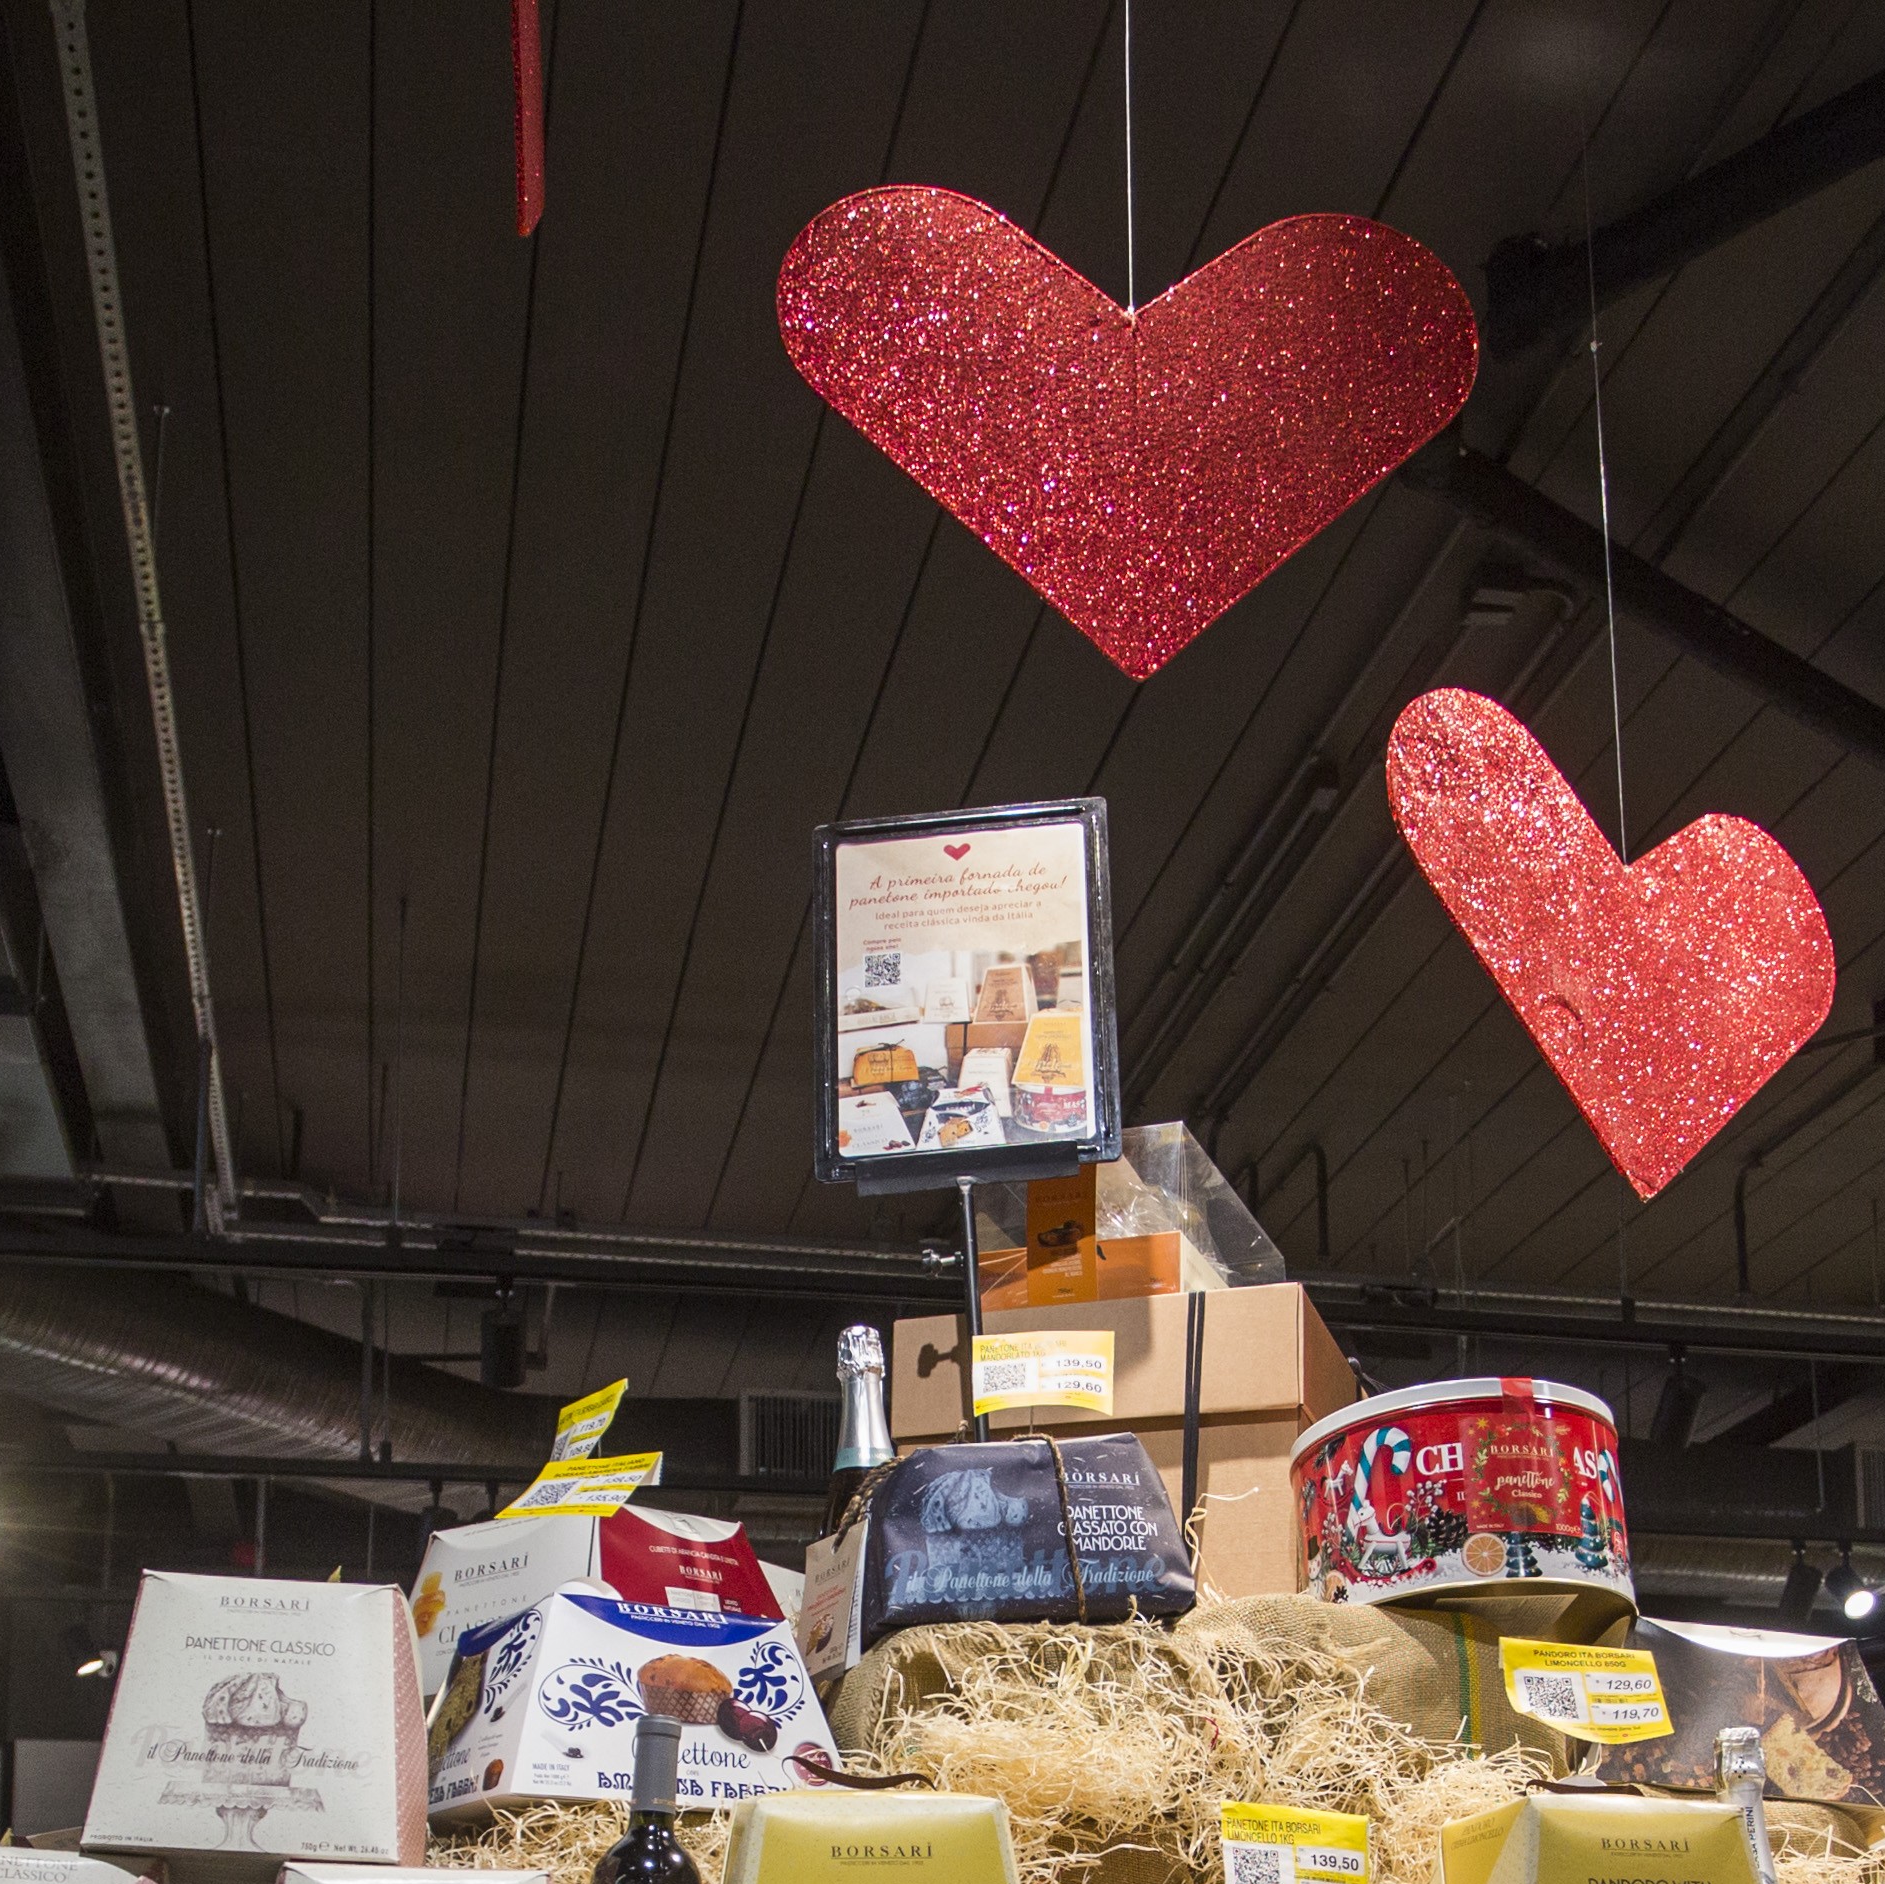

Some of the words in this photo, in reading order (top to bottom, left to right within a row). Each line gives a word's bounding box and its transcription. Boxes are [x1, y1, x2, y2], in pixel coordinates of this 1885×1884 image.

[870, 875, 882, 890] A
[887, 874, 954, 890] primeira
[960, 864, 1021, 885] fornada
[1029, 862, 1046, 876] de
[849, 892, 918, 910] panetone
[924, 881, 1002, 901] importado
[876, 911, 900, 920] Ideal
[903, 909, 925, 919] para
[927, 907, 955, 918] quem
[957, 904, 989, 915] deseja
[991, 902, 1033, 912] apreciar
[884, 921, 919, 930] receita
[922, 916, 960, 927] clássica
[963, 914, 990, 924] vinda
[992, 913, 1004, 921] da
[1007, 911, 1033, 920] Itália
[1057, 1359, 1102, 1369] 139,50
[1057, 1381, 1102, 1393] 129,60
[1129, 1523, 1158, 1536] CON
[1072, 1536, 1147, 1551] MANDORLE
[185, 1636, 266, 1652] PANETTONE
[270, 1640, 335, 1656] CLASSICO
[1533, 1650, 1576, 1658] PANDORO
[274, 1658, 312, 1666] NATALE
[1607, 1680, 1651, 1691] 129,60
[1613, 1707, 1659, 1720] 119,70
[532, 1762, 550, 1771] MADE
[1227, 1818, 1268, 1832] PANETONE
[1271, 1822, 1283, 1831] ITA
[1286, 1823, 1321, 1834] BORSARI
[1746, 1807, 1756, 1840] PERINI
[1227, 1831, 1277, 1843] LIMONCELLO
[1280, 1834, 1294, 1844] 1KG
[1311, 1854, 1359, 1871] 139,50
